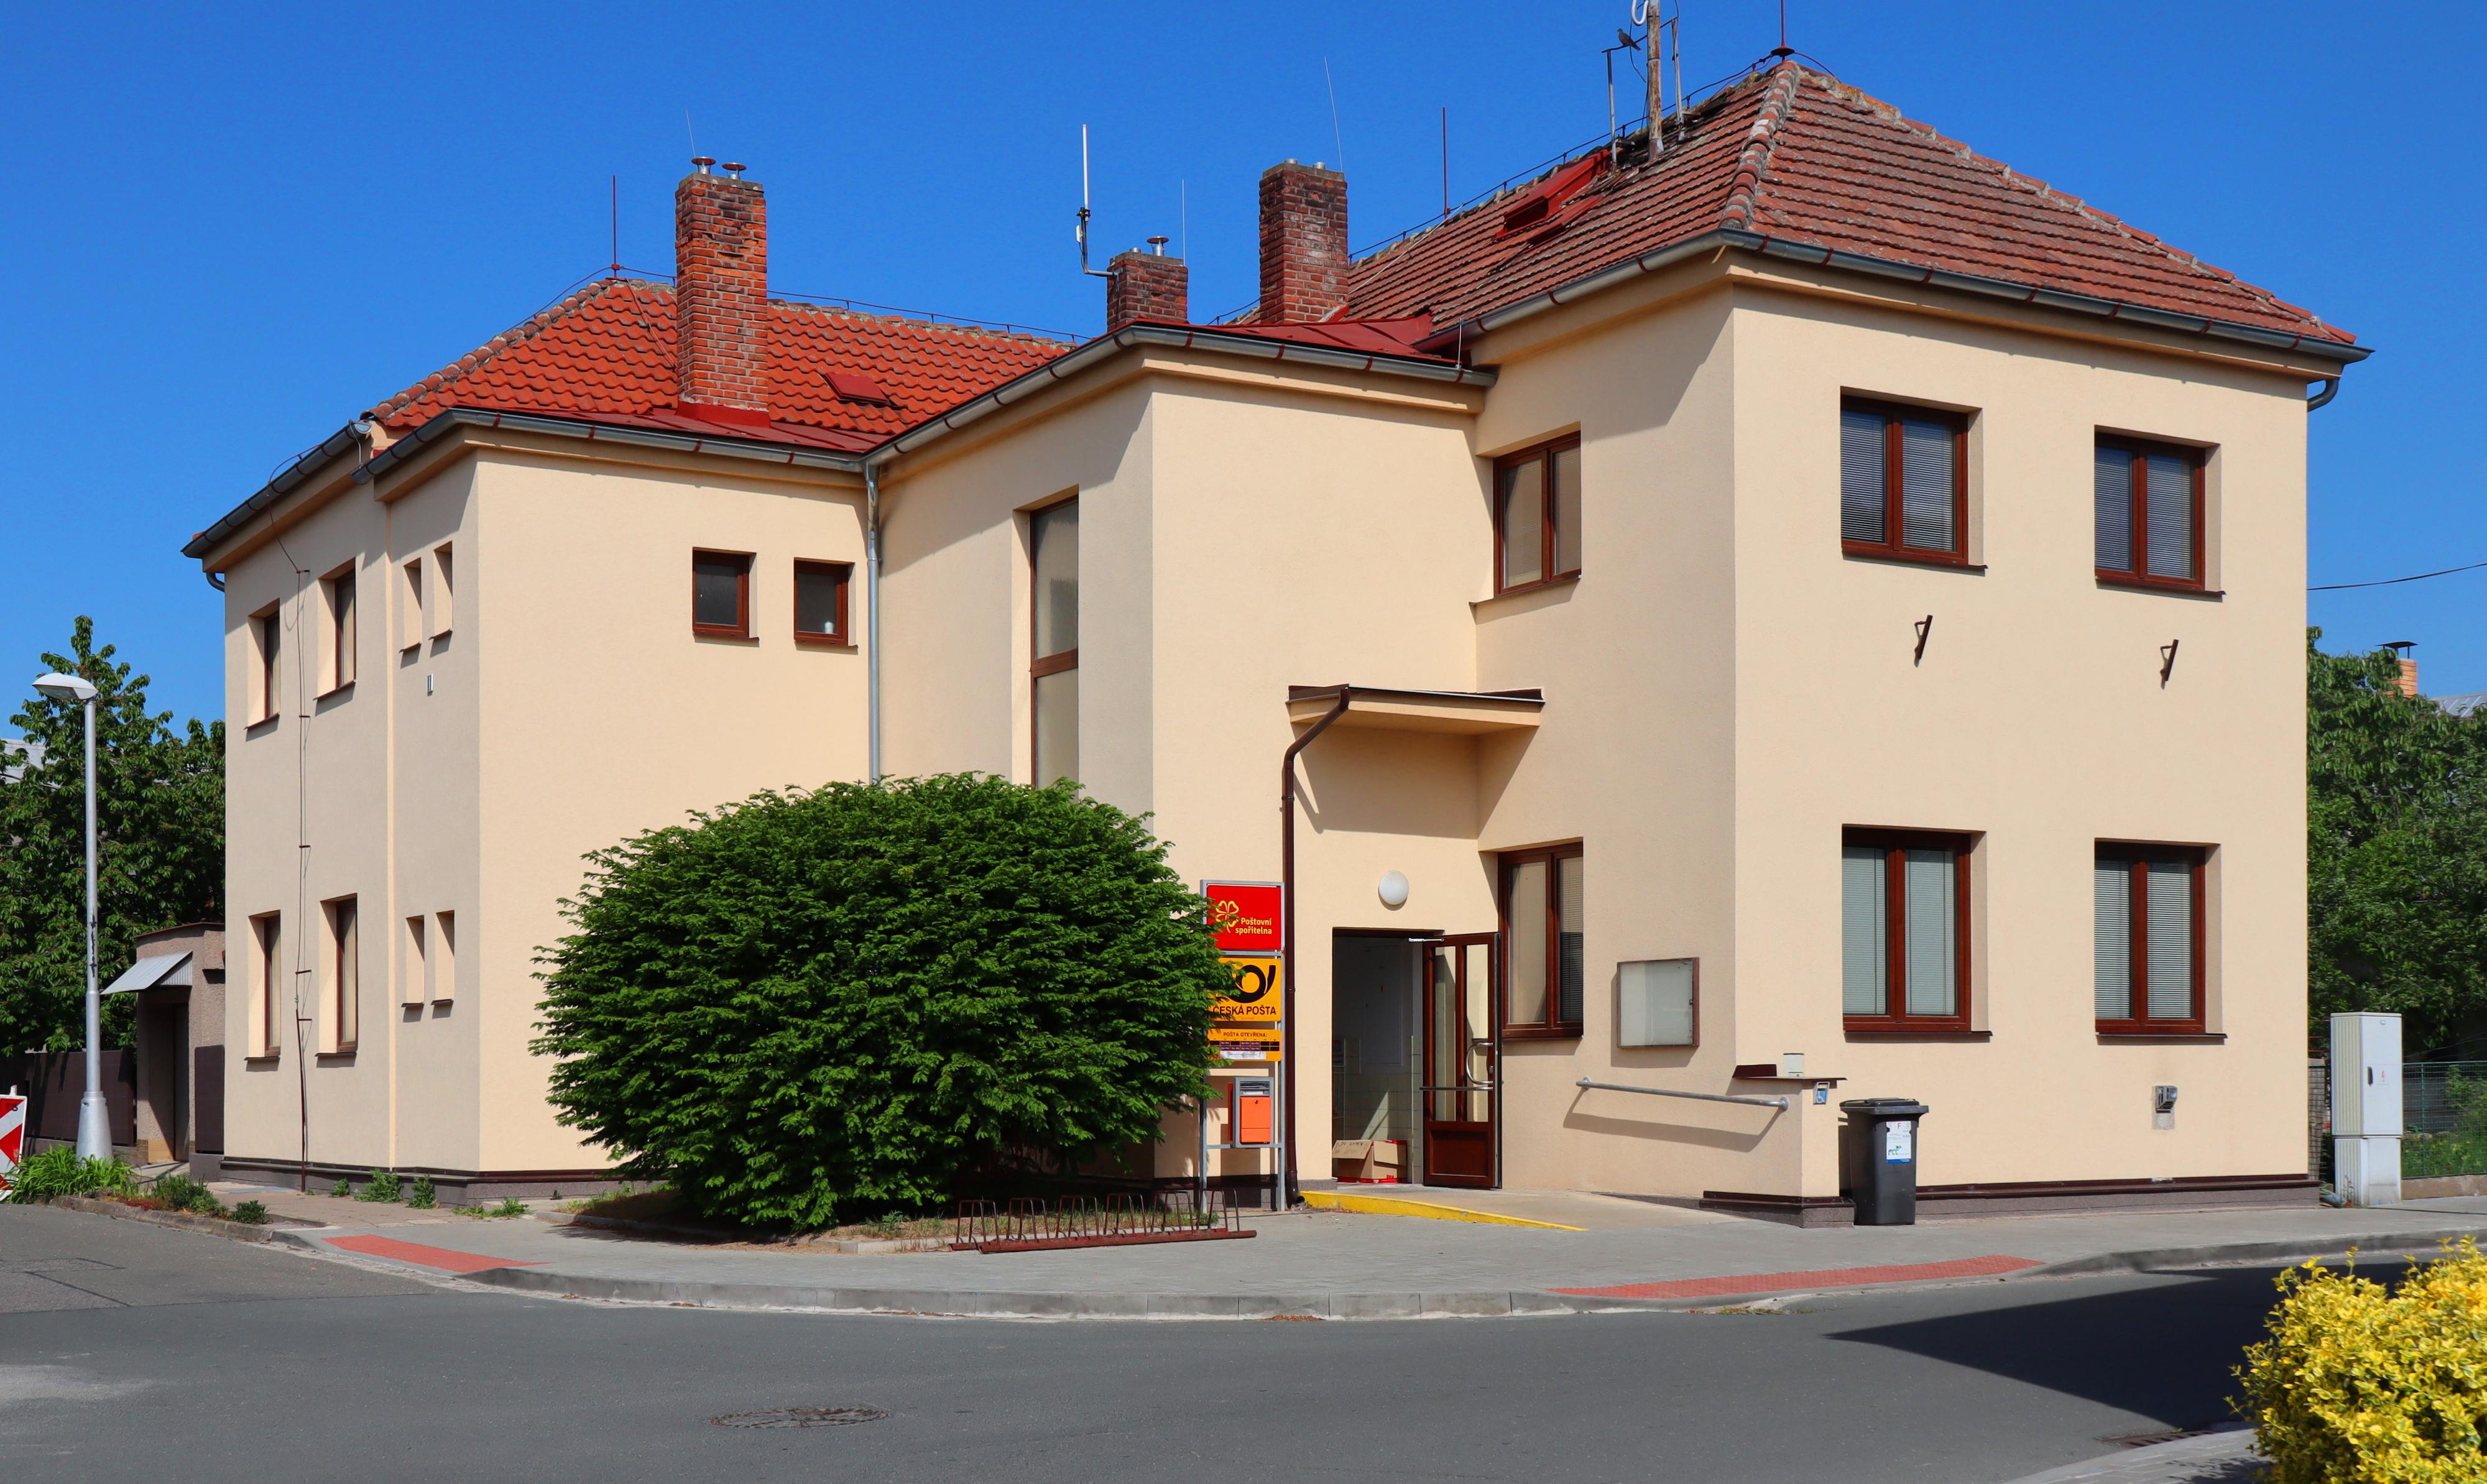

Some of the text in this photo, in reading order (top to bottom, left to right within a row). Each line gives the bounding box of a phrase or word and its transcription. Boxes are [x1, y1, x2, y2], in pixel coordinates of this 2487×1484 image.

[1241, 917, 1272, 926] Poštovní
[1235, 926, 1272, 935] spořitelna
[1246, 1005, 1276, 1015] POŠTA
